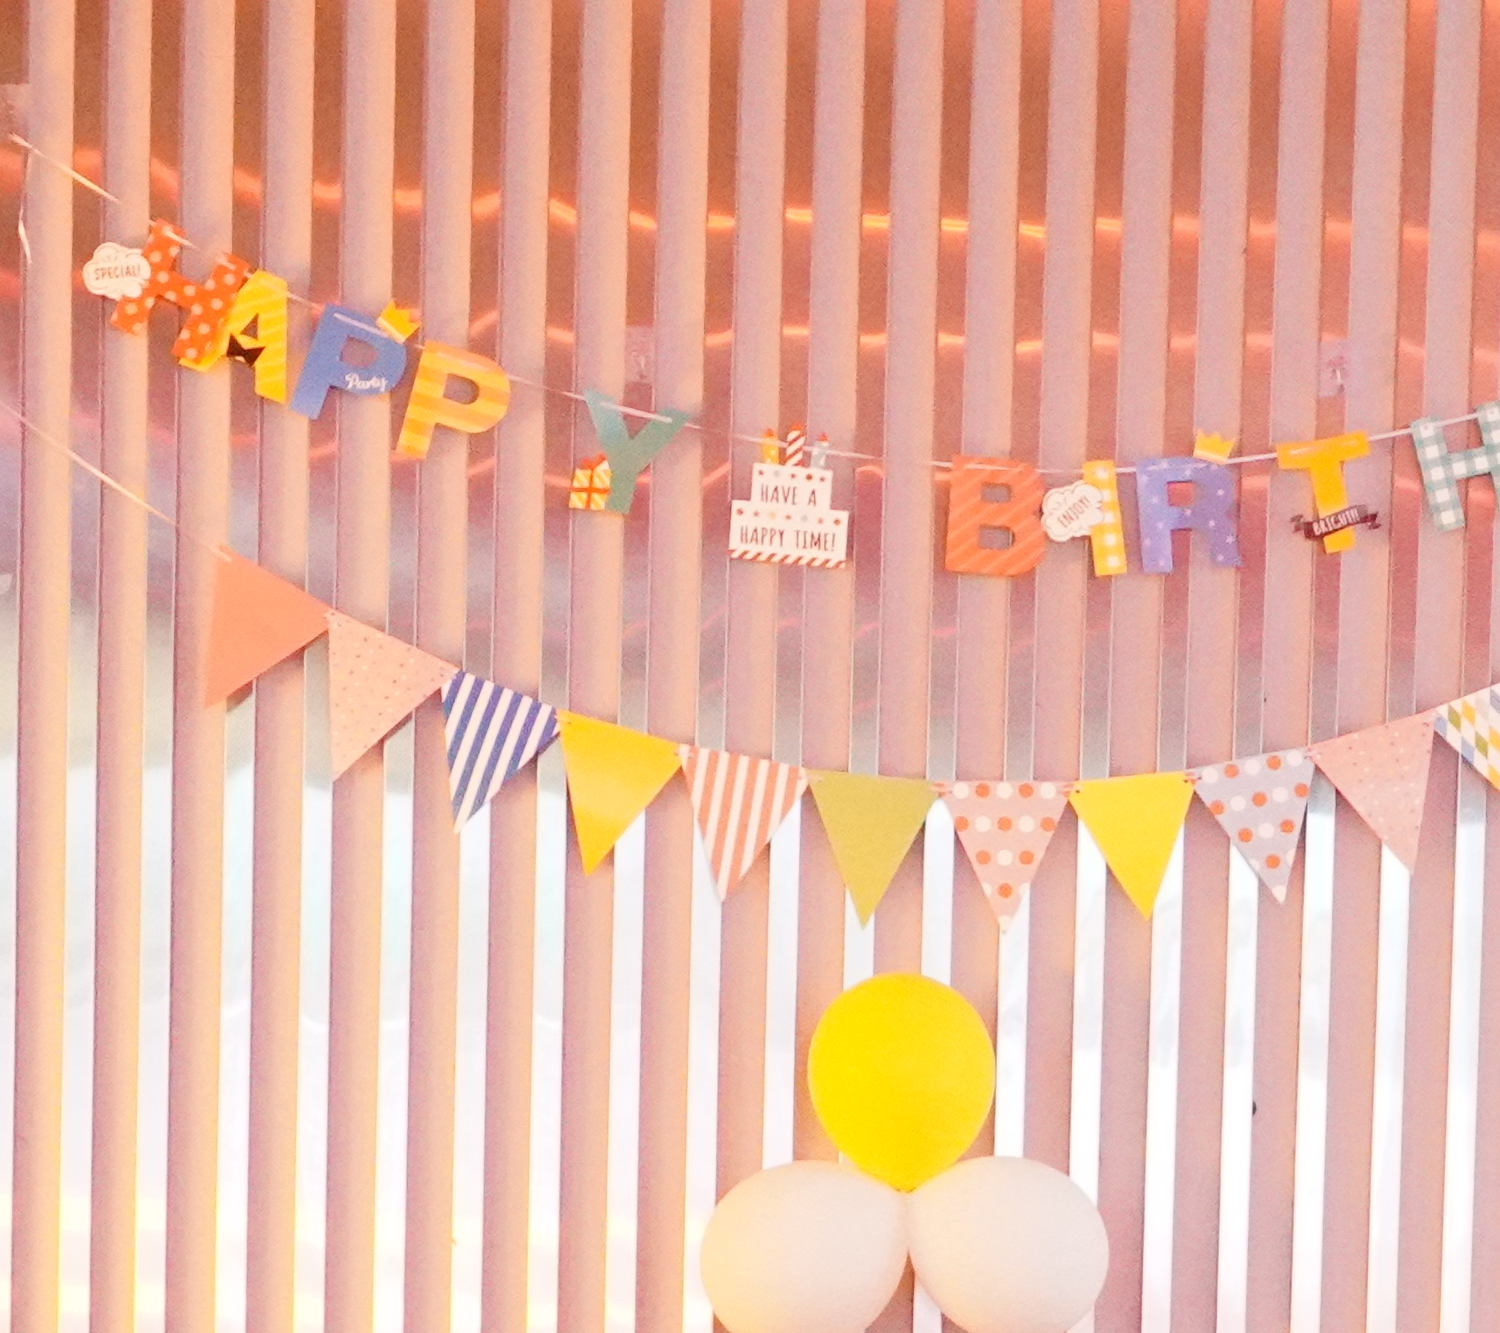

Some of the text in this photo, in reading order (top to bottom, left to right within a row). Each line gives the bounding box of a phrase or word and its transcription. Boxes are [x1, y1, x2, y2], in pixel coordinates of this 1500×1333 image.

[109, 217, 690, 514] HAPPY
[344, 372, 388, 392] Party
[760, 483, 817, 507] HAVE A
[740, 525, 836, 552] HAPPY TIME!
